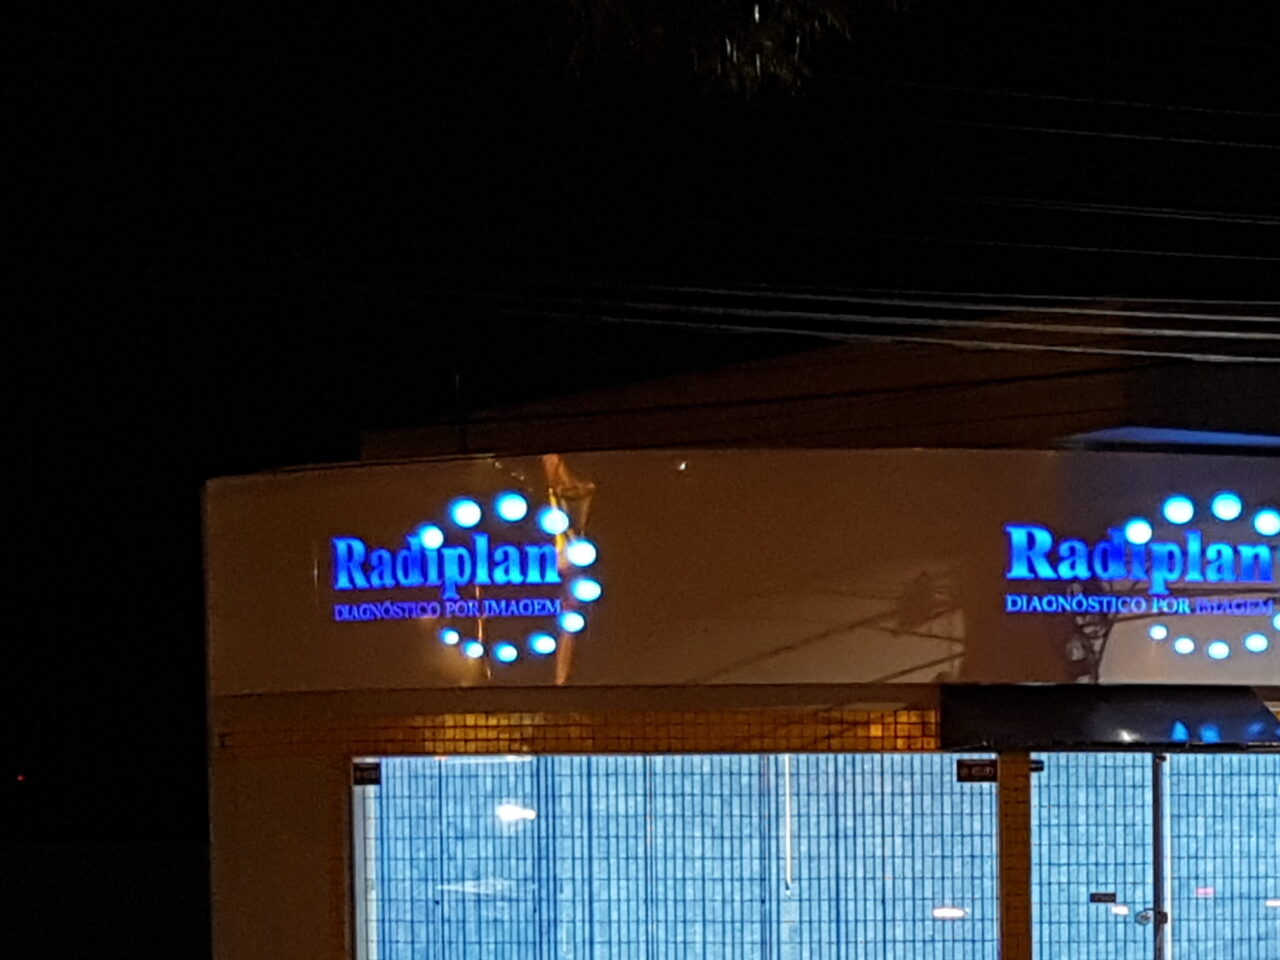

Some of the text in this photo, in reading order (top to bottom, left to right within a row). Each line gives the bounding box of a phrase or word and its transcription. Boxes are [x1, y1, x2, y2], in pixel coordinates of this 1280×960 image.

[331, 533, 562, 600] Radiplan
[1005, 522, 1274, 595] Radiplan
[334, 598, 561, 621] DIAGNÓSTICO POR IMAGEM
[1006, 595, 1147, 614] DIAGNÓSTICO
[1152, 597, 1192, 614] POR
